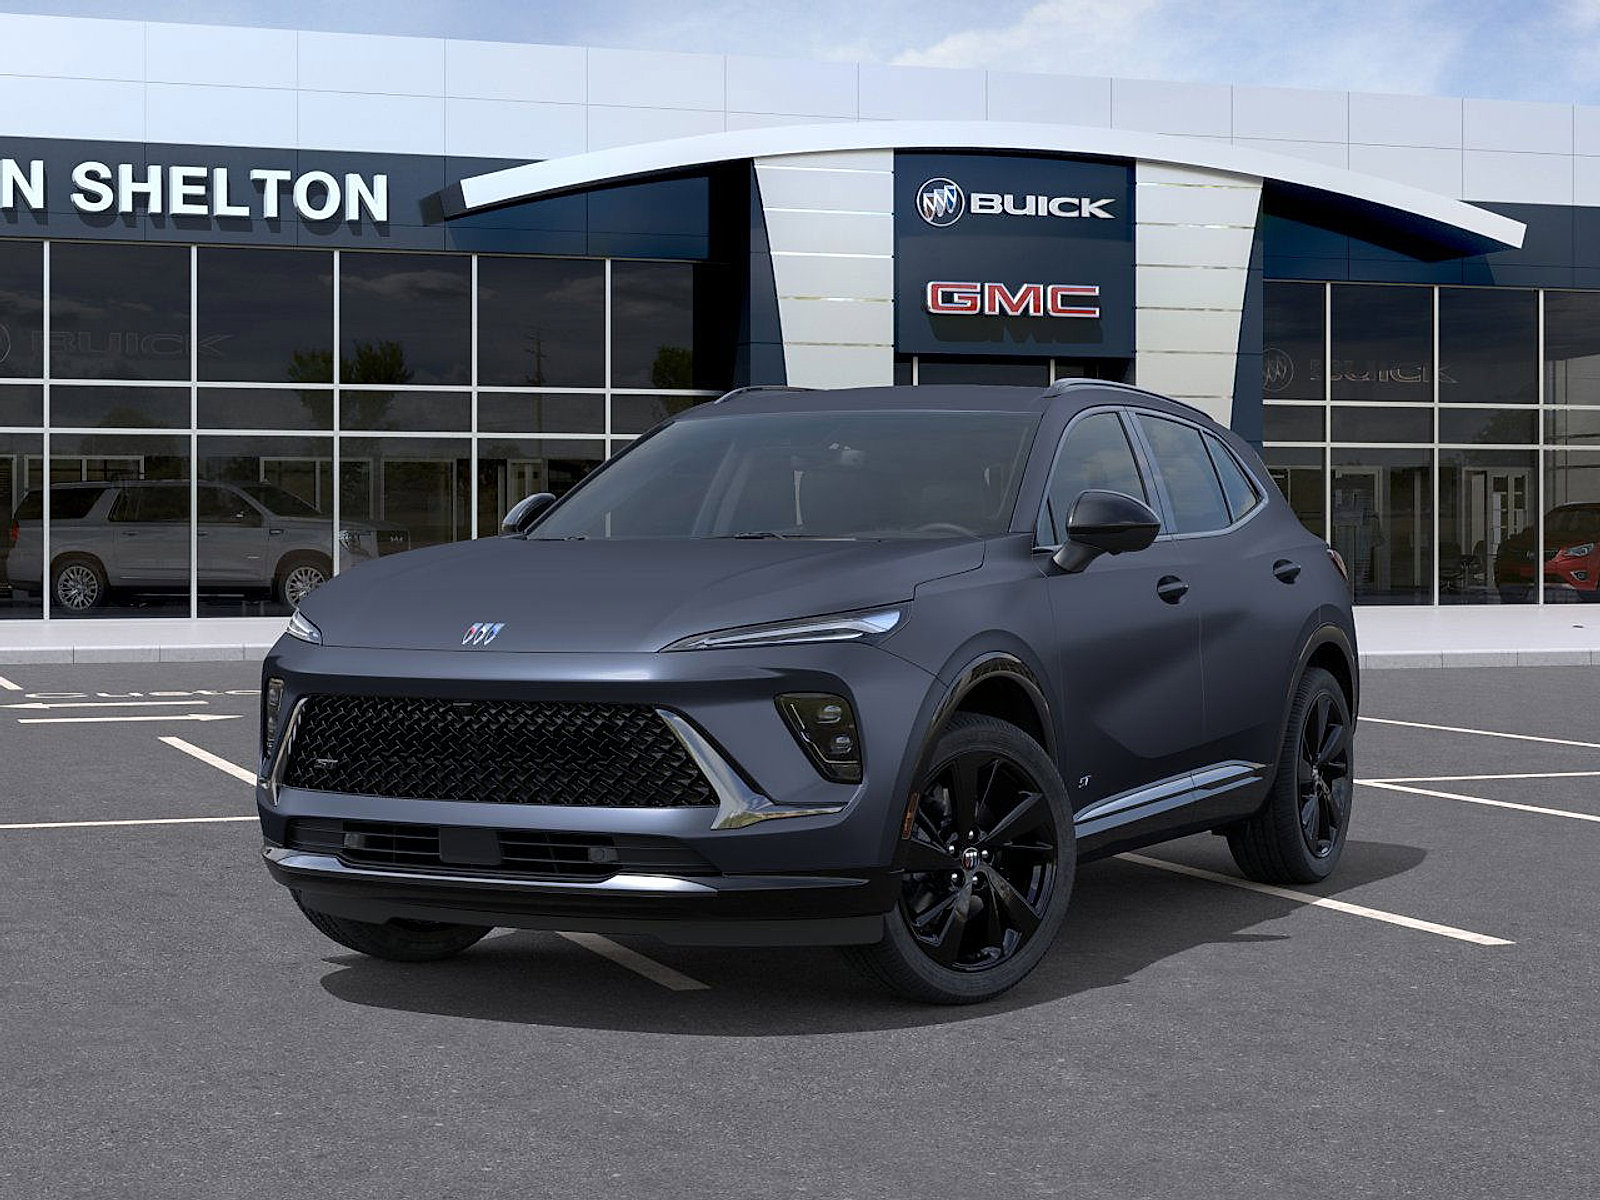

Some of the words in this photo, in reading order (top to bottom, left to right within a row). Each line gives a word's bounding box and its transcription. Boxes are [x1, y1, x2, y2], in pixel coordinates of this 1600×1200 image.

[0, 158, 44, 209] N
[70, 161, 388, 222] SHELTON
[970, 193, 1116, 219] BUICK
[927, 281, 1100, 318] GMC
[31, 330, 234, 358] BUICK
